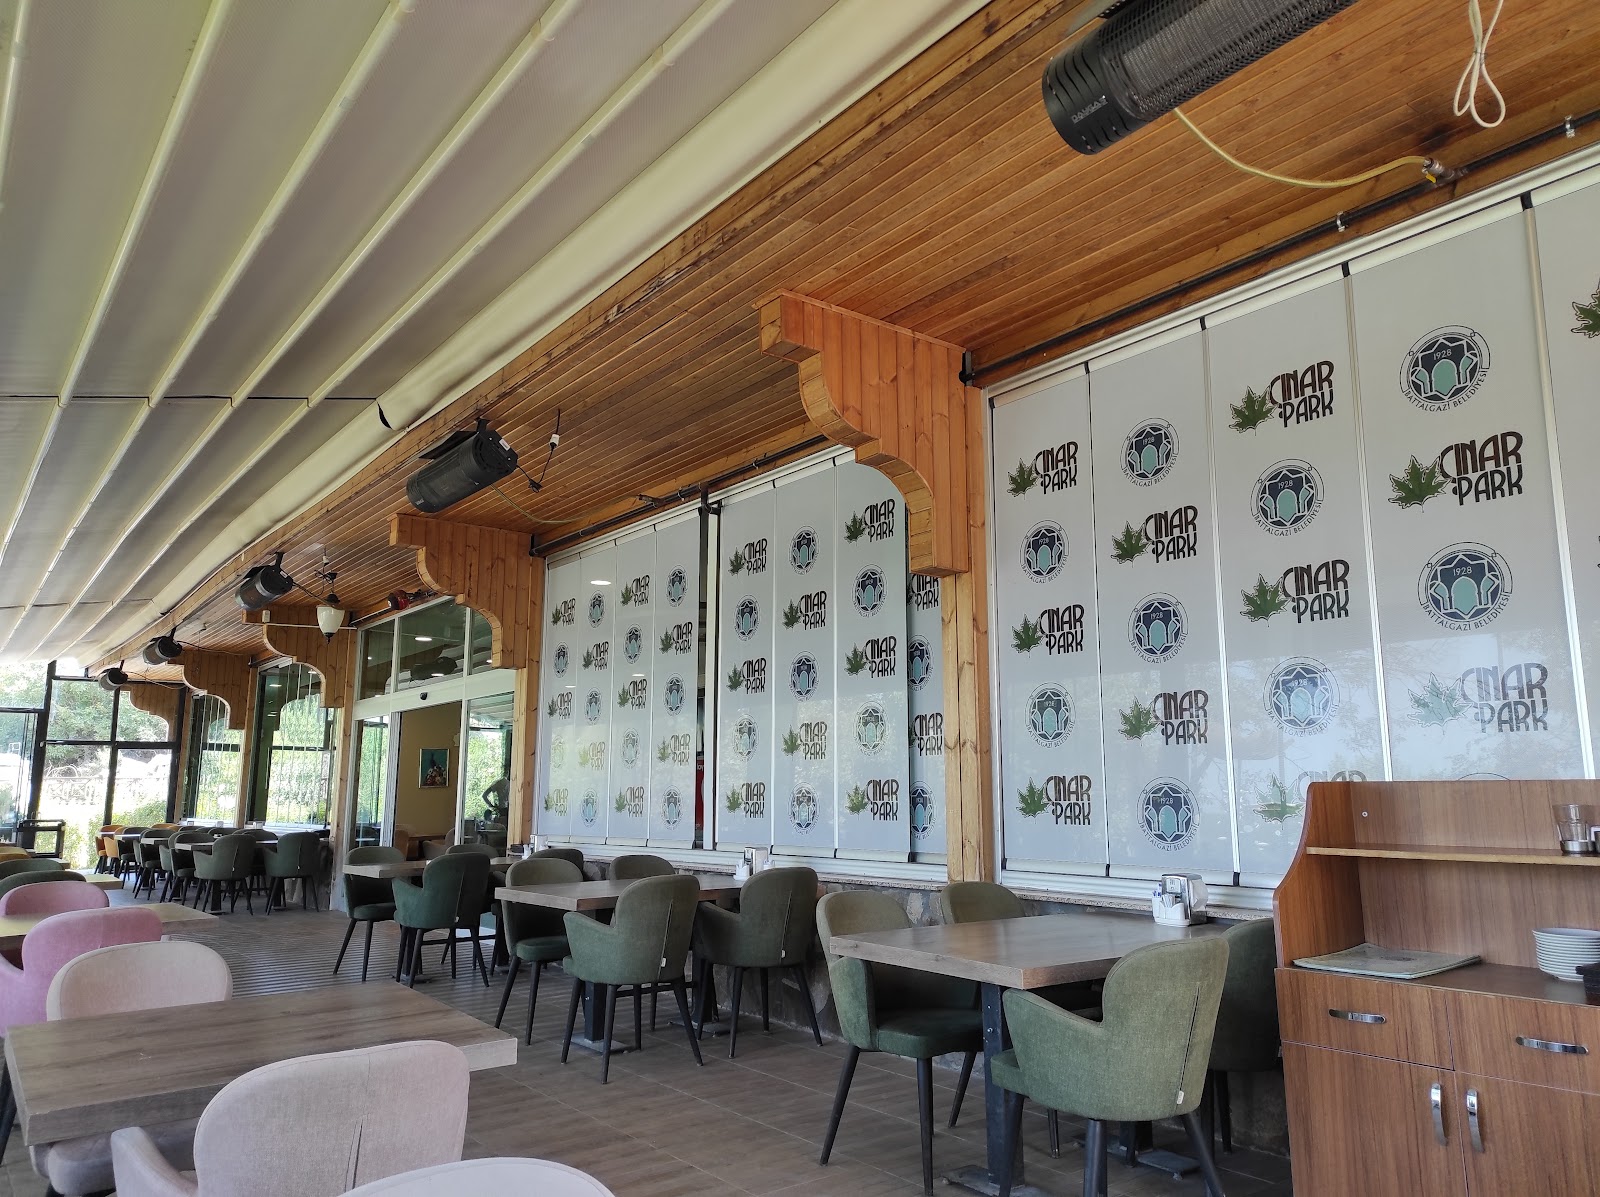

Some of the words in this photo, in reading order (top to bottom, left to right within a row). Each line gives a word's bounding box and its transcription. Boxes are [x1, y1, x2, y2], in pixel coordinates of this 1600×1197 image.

[1433, 349, 1452, 361] 1928
[1283, 388, 1334, 428] PARK
[1043, 464, 1078, 495] PARK
[1278, 480, 1294, 489] 1928
[1457, 464, 1523, 506] PARK
[869, 518, 895, 543] PARK
[1155, 532, 1197, 563] PARK
[747, 555, 767, 576] PARK
[1453, 566, 1472, 576] 1928
[917, 589, 939, 612] PARK
[1296, 590, 1350, 624] PARK
[804, 609, 826, 631] PARK
[1049, 629, 1084, 655] PARK
[870, 656, 896, 679] PARK
[746, 675, 766, 694] PARK
[1479, 699, 1549, 733] PARK
[1165, 718, 1208, 746] PARK
[804, 741, 827, 760] PARK
[919, 734, 943, 757] PARK
[745, 800, 765, 819] PARK
[872, 801, 898, 821] PARK
[1055, 802, 1091, 826] PARK
